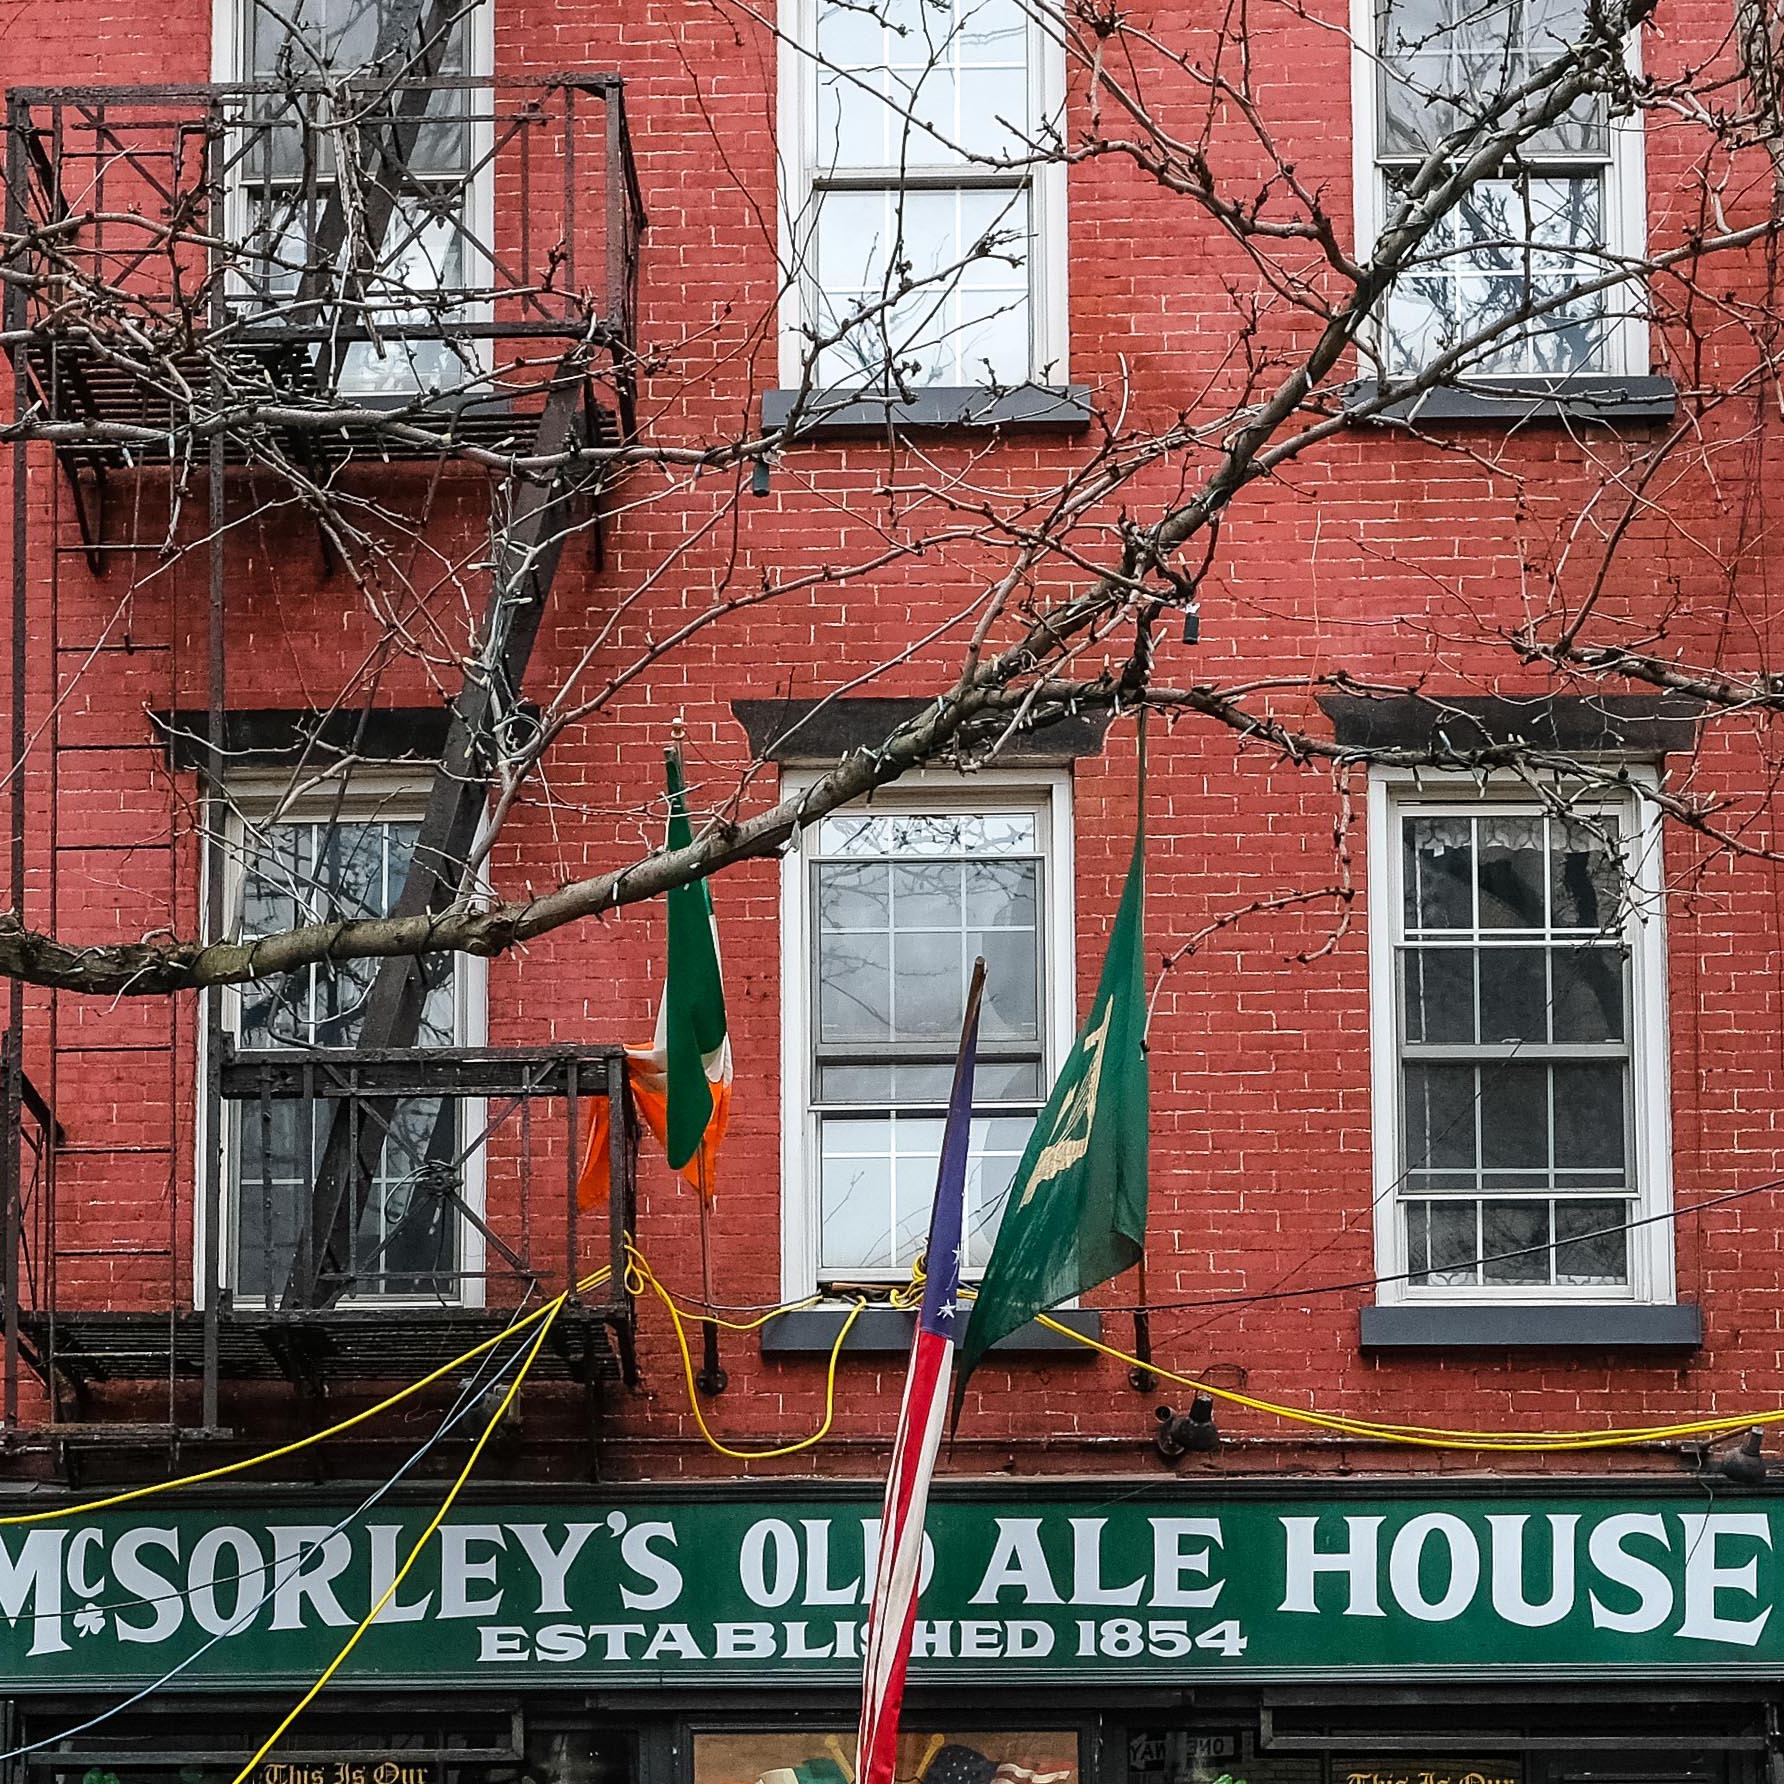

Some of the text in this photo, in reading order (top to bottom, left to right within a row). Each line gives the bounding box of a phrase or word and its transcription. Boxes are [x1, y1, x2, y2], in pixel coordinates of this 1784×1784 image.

[968, 1516, 1227, 1607] ALE
[1280, 1512, 1774, 1646] HOUSE
[477, 1619, 1248, 1662] ESTABLIHED 1854
